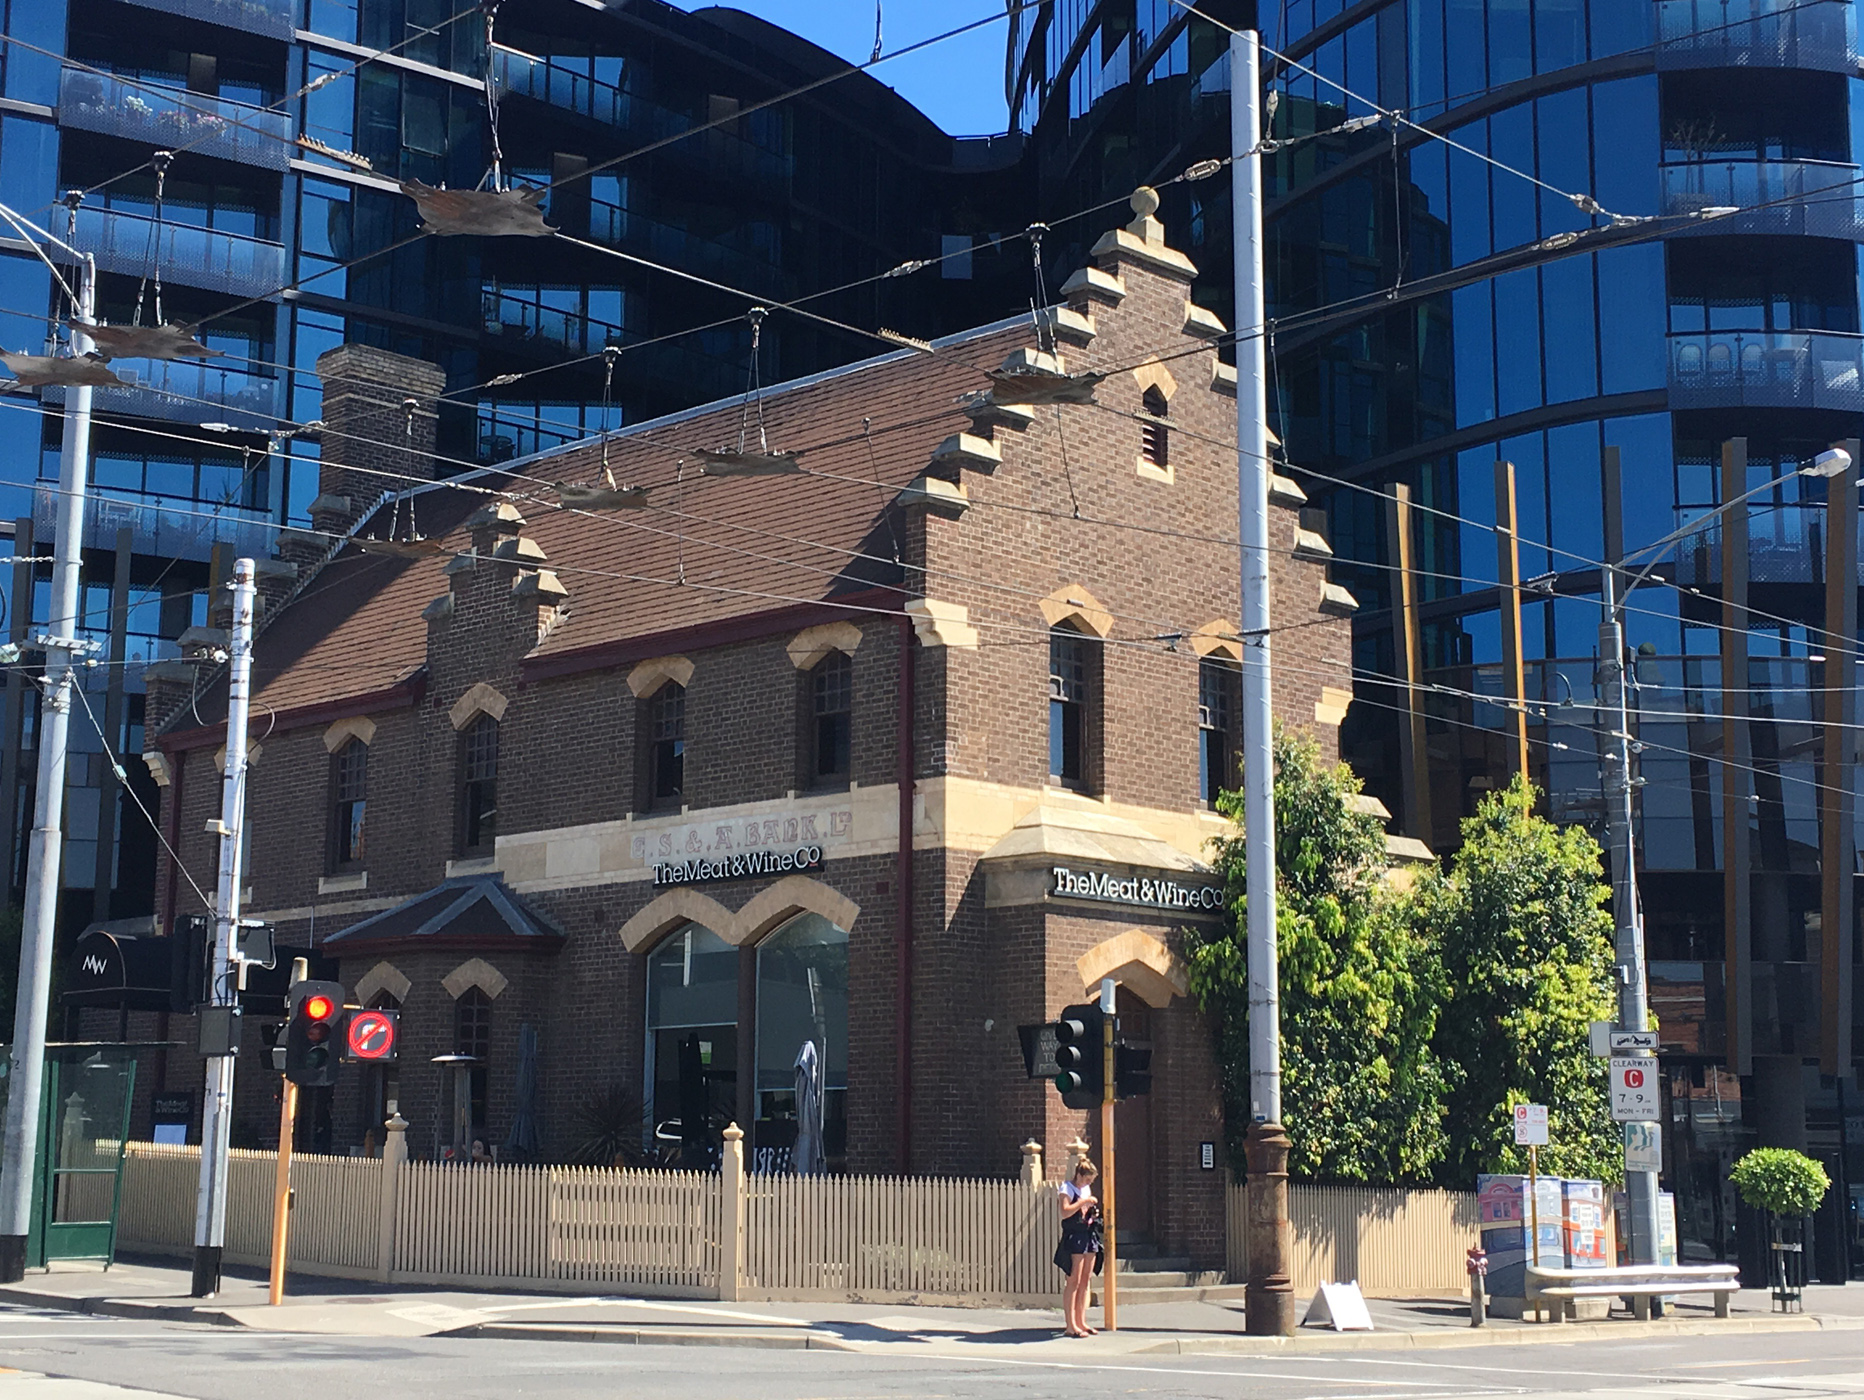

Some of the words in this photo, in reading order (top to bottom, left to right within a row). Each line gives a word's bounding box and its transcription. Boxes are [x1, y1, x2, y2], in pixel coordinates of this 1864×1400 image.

[82, 954, 107, 975] MW
[1612, 1060, 1654, 1068] CLEARWAY
[1629, 1070, 1639, 1087] C
